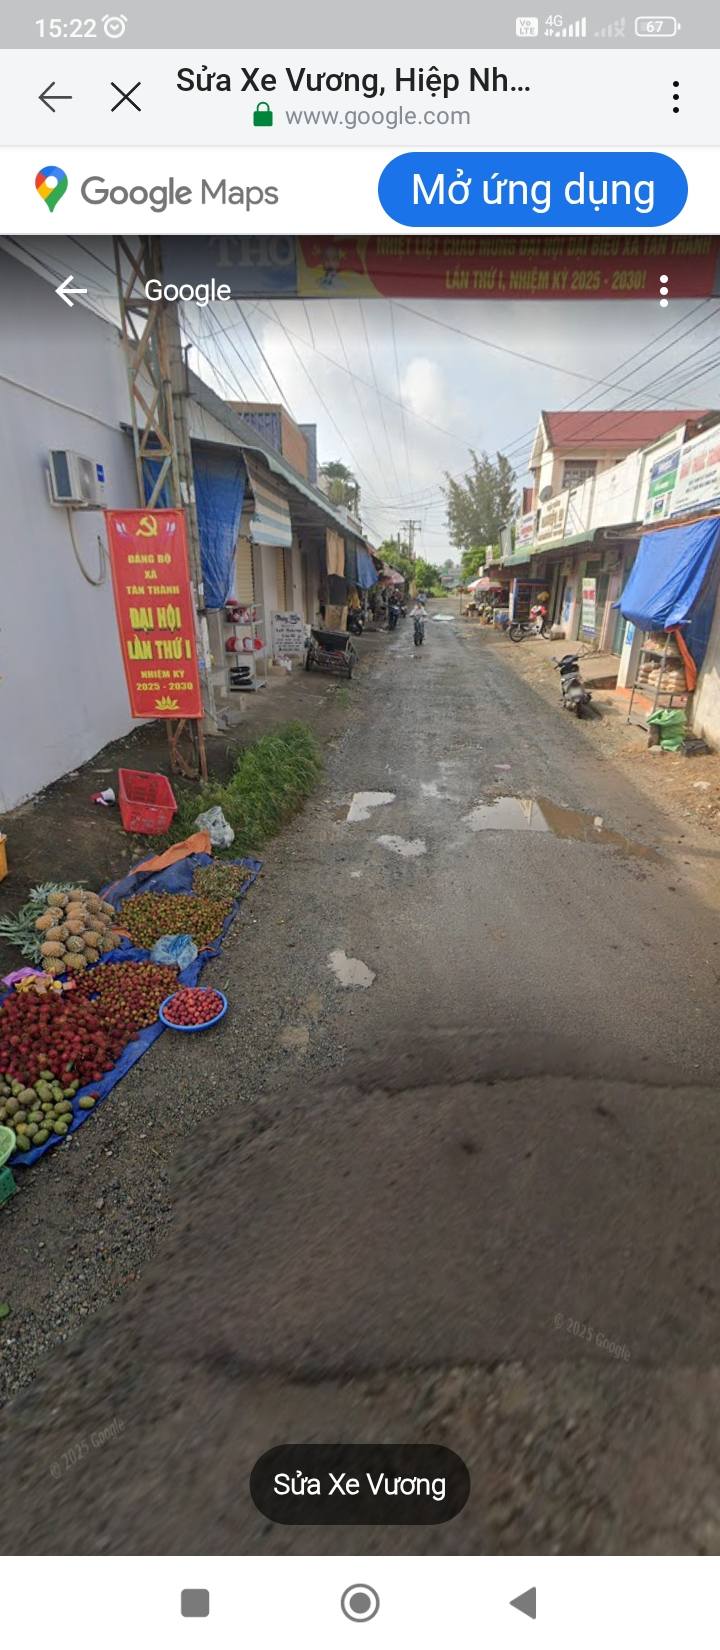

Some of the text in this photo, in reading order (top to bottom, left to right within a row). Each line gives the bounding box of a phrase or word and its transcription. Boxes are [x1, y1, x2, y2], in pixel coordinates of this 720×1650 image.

[35, 18, 97, 38] 15:22
[545, 15, 563, 27] 4G
[646, 20, 664, 33] 67
[176, 65, 232, 92] Sửa
[241, 67, 277, 92] Xe
[286, 67, 386, 99] Vương,
[395, 66, 460, 98] Hiệp
[285, 106, 471, 129] www.google.com
[81, 176, 279, 213] Google Maps
[413, 169, 654, 214] Mở ứng dụng
[510, 266, 549, 293] NHIỆM
[571, 270, 601, 290] 2025
[611, 269, 647, 290] 2030!
[129, 603, 182, 632] ĐẠI HỘI
[127, 634, 192, 660] LẦN THỨ I
[136, 682, 161, 691] 2025
[168, 682, 194, 691] 2030
